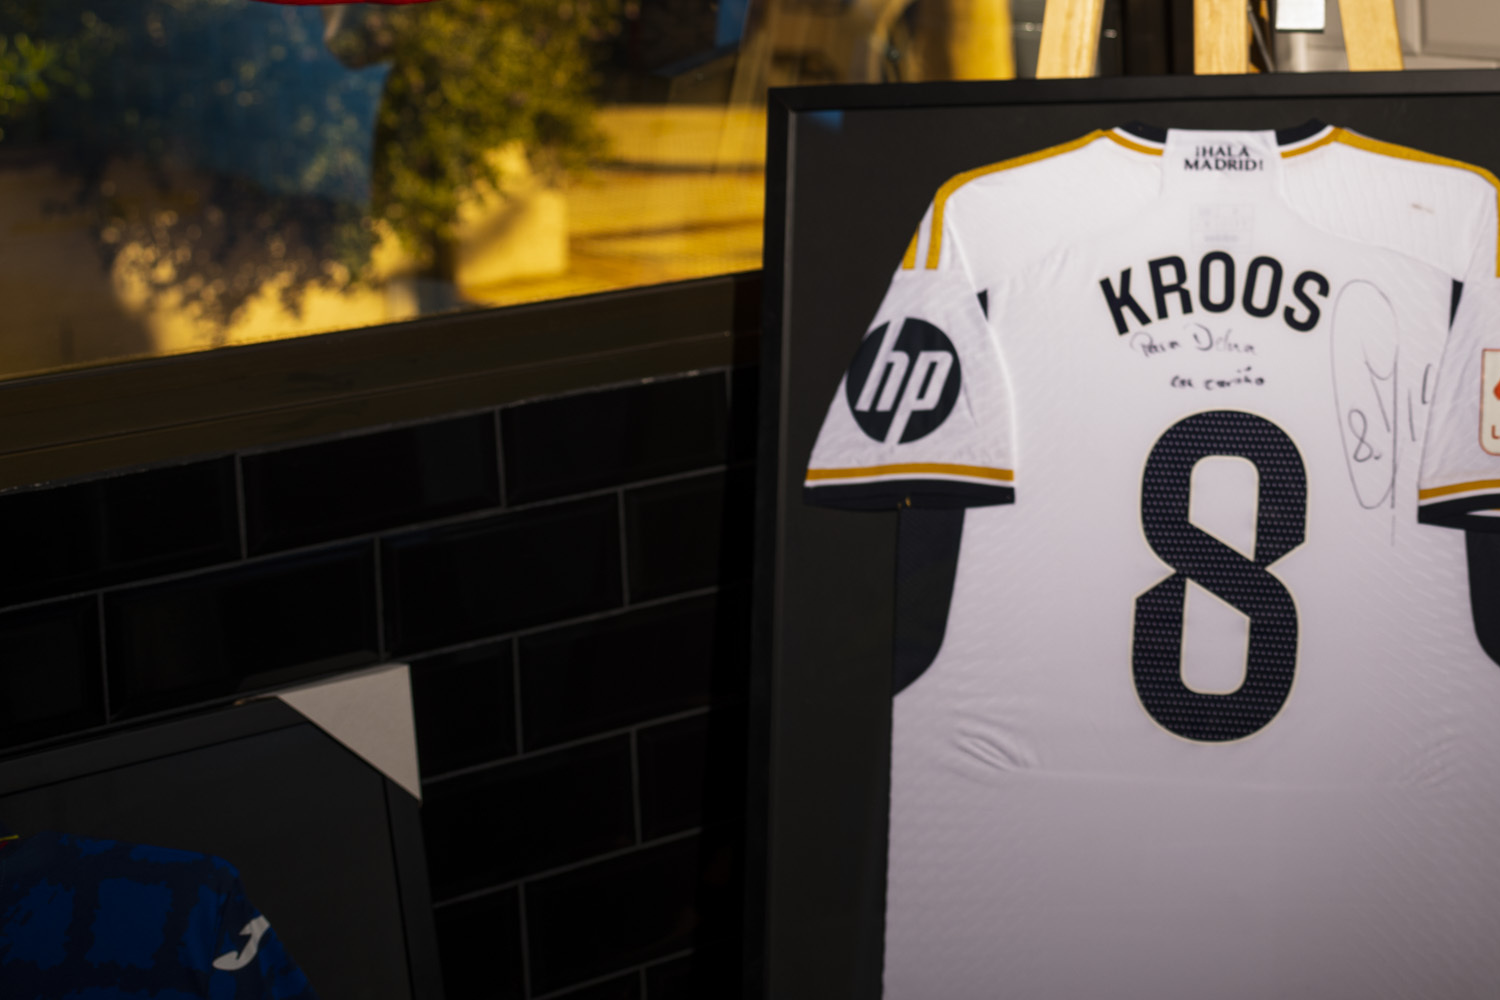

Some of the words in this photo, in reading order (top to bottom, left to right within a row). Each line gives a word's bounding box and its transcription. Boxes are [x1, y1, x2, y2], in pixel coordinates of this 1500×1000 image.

[1184, 158, 1264, 171] MADRID!
[1195, 145, 1250, 157] ¡HALA
[1099, 251, 1330, 335] KROOS
[854, 318, 954, 444] hp
[1130, 408, 1309, 745] 8
